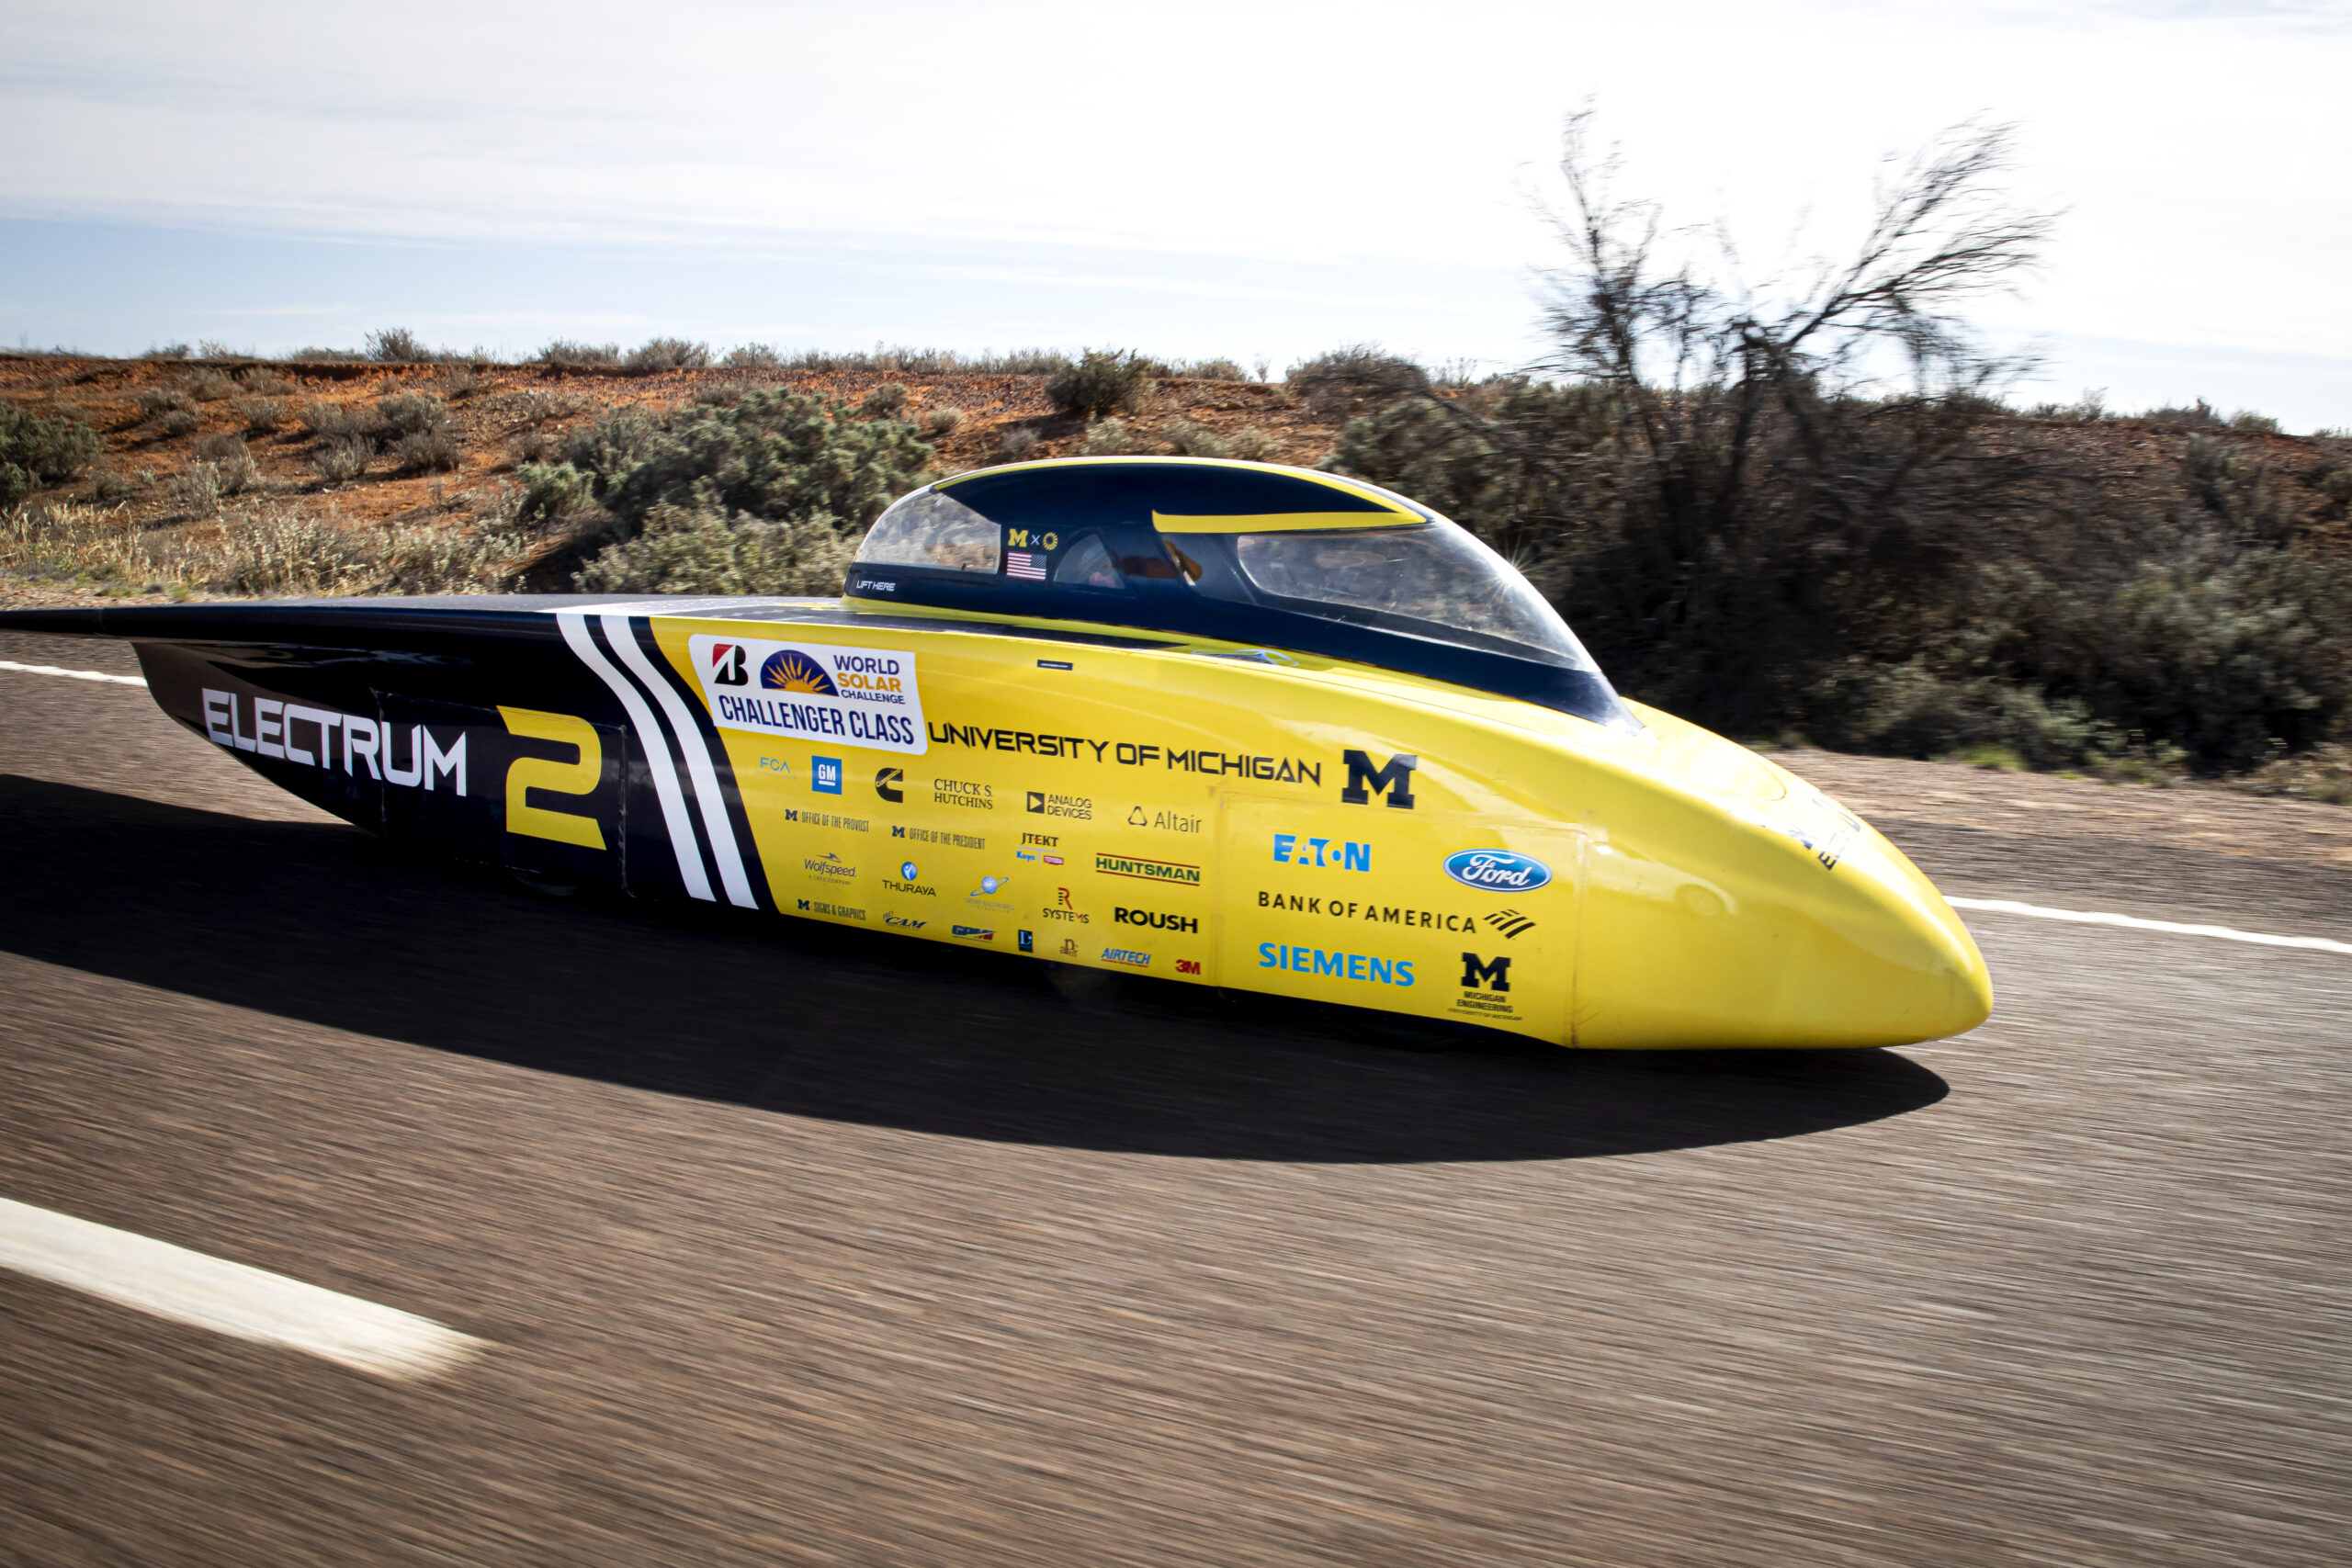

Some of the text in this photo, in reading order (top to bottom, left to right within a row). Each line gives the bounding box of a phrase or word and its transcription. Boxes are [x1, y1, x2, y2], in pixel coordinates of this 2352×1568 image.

[856, 580, 896, 592] LIFT HERE
[833, 654, 899, 675] WORLD
[837, 672, 902, 694] SOLAR
[841, 689, 905, 705] CHALLENGE
[718, 694, 914, 745] CHALLENGER CLASS
[202, 688, 467, 796] ELECTRUM
[760, 756, 791, 773] FCA
[928, 722, 1320, 787] UNIVERSITY OF MICHIGAN
[496, 705, 606, 850] 2
[818, 763, 836, 781] GM
[1341, 750, 1418, 809] M
[933, 778, 993, 796] CHUCK S.
[933, 792, 993, 809] HUTCHINS
[1047, 794, 1092, 808] ANALOG
[801, 811, 820, 826] OFFICE
[821, 815, 829, 827] OF
[831, 816, 842, 829] THE
[842, 817, 870, 832] PROVOST
[1047, 805, 1092, 820] DEVICES
[1154, 810, 1203, 833] Altair
[909, 828, 929, 842] OFFICE
[931, 830, 939, 843] OF
[940, 831, 951, 846] THE
[952, 834, 986, 850] PRESIDENT
[1021, 832, 1058, 847] JTEKT
[1273, 833, 1371, 873] EATON
[804, 859, 855, 877] Wolfspeed
[1096, 857, 1200, 882] HUNTSMAN
[1462, 854, 1535, 886] Ford
[882, 879, 936, 897] THURAYA
[813, 901, 831, 915] SIGNS
[831, 904, 837, 916] &
[838, 905, 866, 921] GRAPHICS
[1043, 908, 1090, 924] SYSTEMS
[1114, 907, 1198, 933] ROUSH
[1258, 891, 1477, 934] BANK OF AMERICA
[1101, 948, 1151, 964] AIRTECH
[1259, 942, 1416, 987] SIEMENS
[1176, 959, 1201, 976] 3M
[1461, 952, 1511, 992] M
[1456, 998, 1514, 1013] ENGINEERING
[1464, 991, 1507, 1003] MICHIGAN
